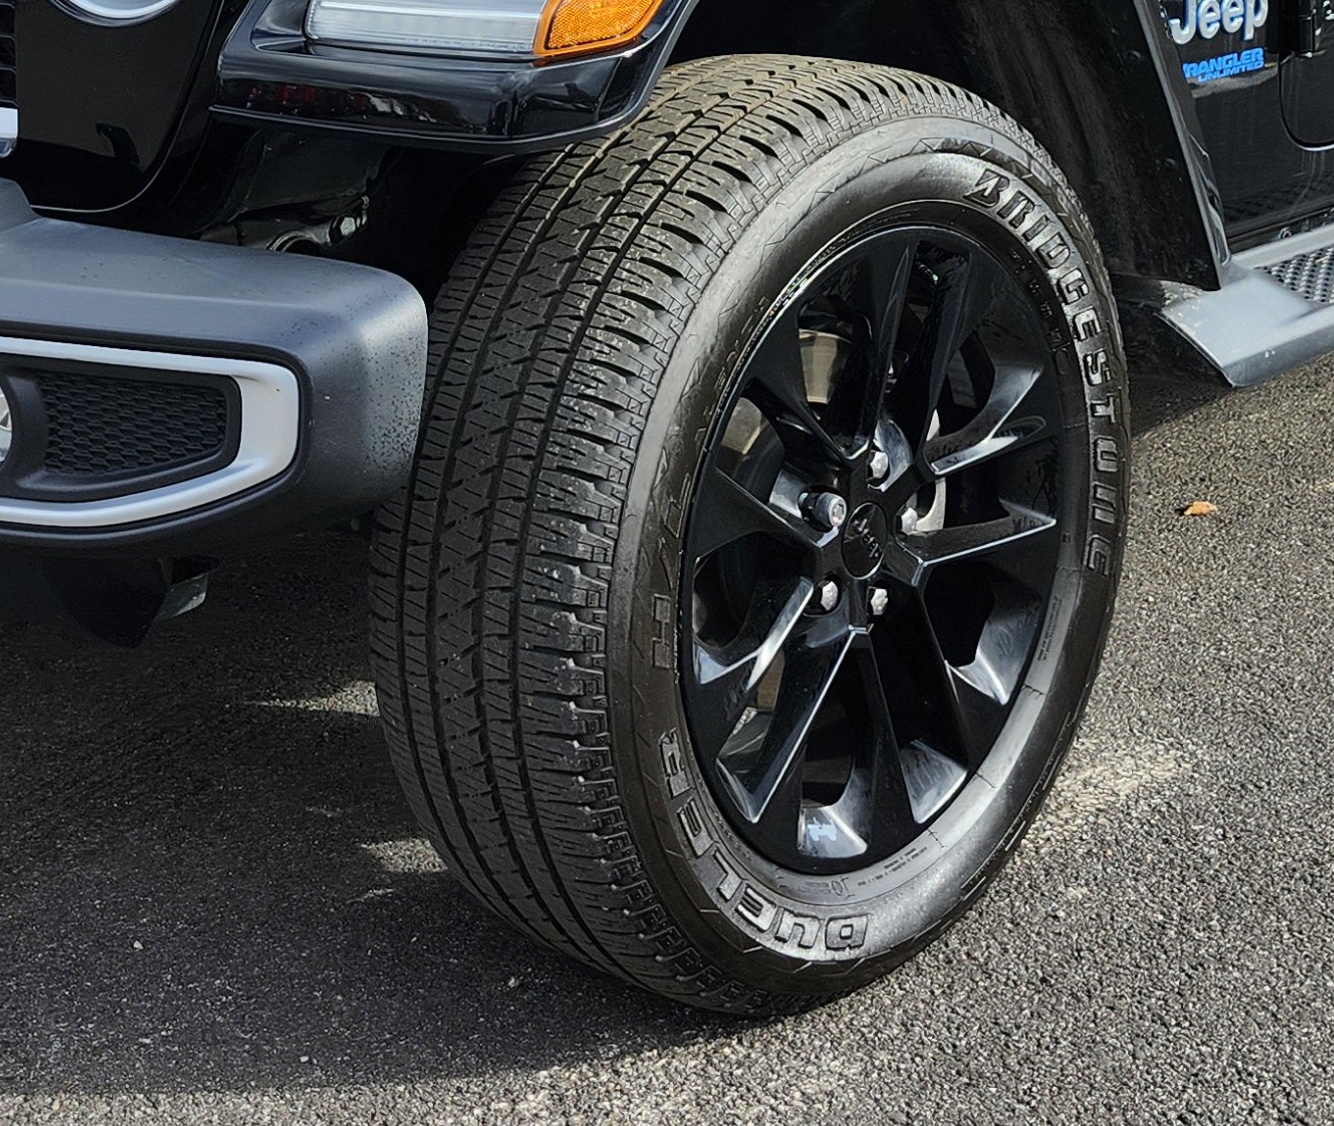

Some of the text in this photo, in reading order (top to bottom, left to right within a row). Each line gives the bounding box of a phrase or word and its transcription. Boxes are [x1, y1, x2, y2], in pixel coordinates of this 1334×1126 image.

[1197, 61, 1264, 83] UNLIMITED
[963, 168, 1118, 577] BRIDGESTONE
[659, 728, 869, 949] DUELER
